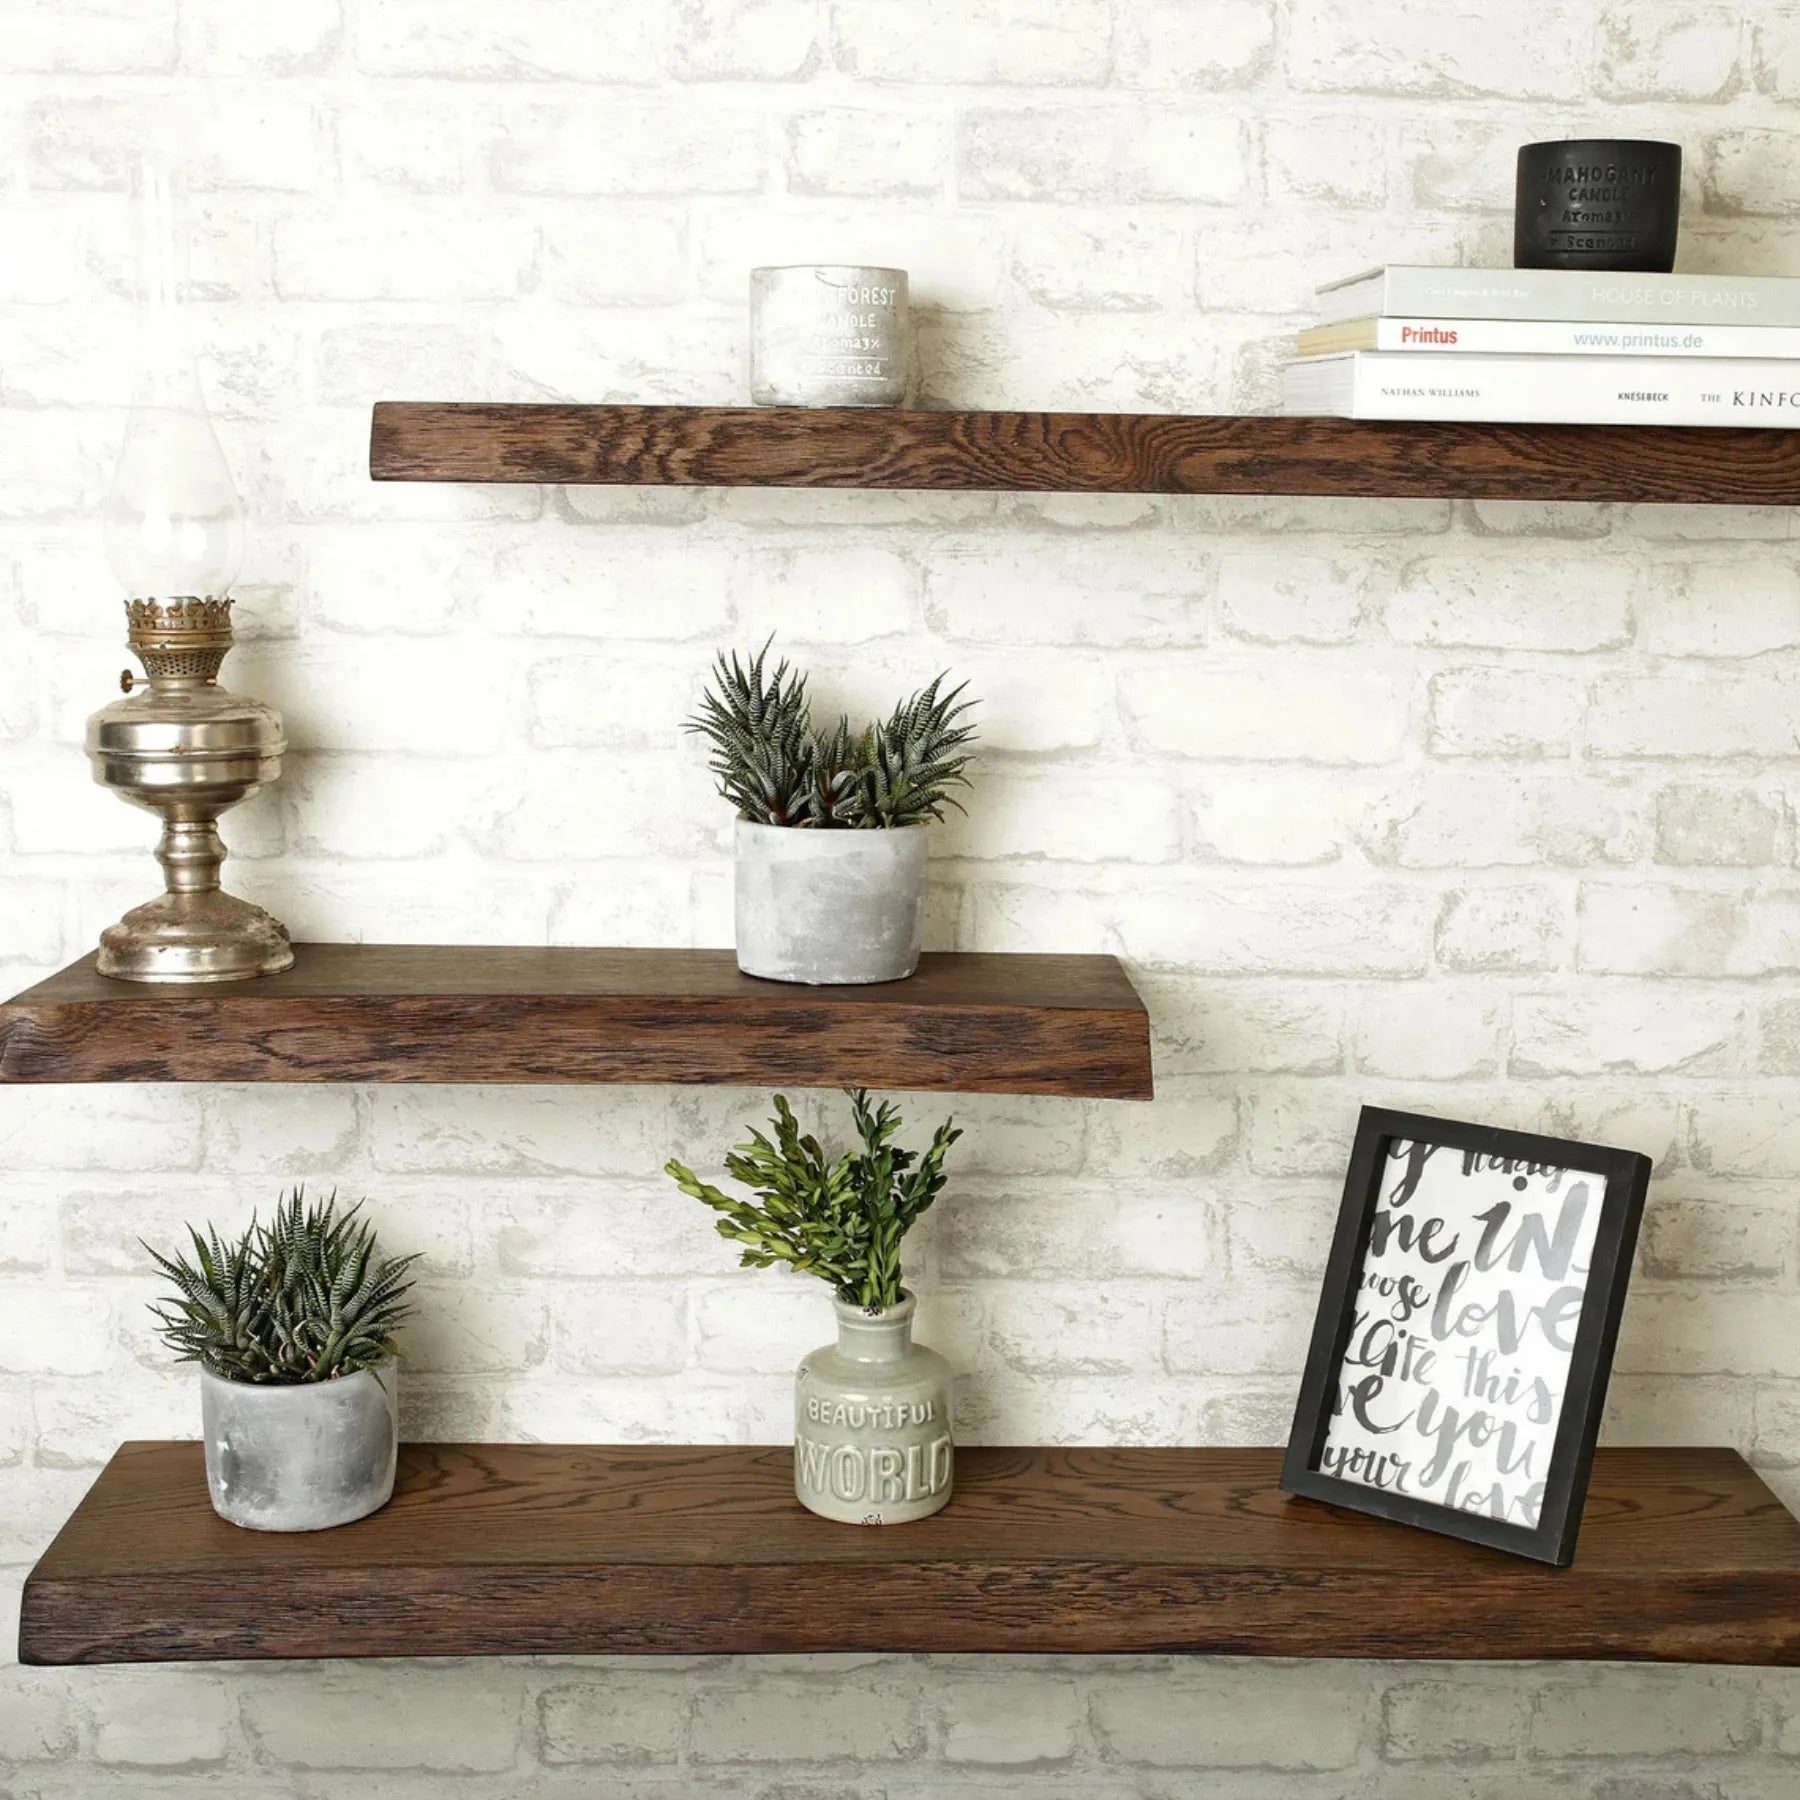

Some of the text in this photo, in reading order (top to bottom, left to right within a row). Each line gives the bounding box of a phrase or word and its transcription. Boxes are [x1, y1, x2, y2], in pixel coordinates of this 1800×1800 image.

[1545, 166, 1657, 184] MAHOGANY
[1568, 187, 1632, 201] CANDLE
[838, 286, 896, 305] FOREST
[1592, 287, 1757, 307] HOUSE OF PLANTS
[1402, 326, 1703, 349] Printus www.printus.de
[1381, 387, 1425, 397] NATHAN
[1428, 388, 1480, 398] WILLIAMS
[1618, 391, 1669, 402] KNESEBECK
[1701, 393, 1721, 402] THE
[808, 1397, 934, 1429] BEAUTIFUL
[1416, 1388, 1537, 1488] you
[796, 1434, 951, 1502] WORLD
[1323, 1446, 1411, 1493] your
